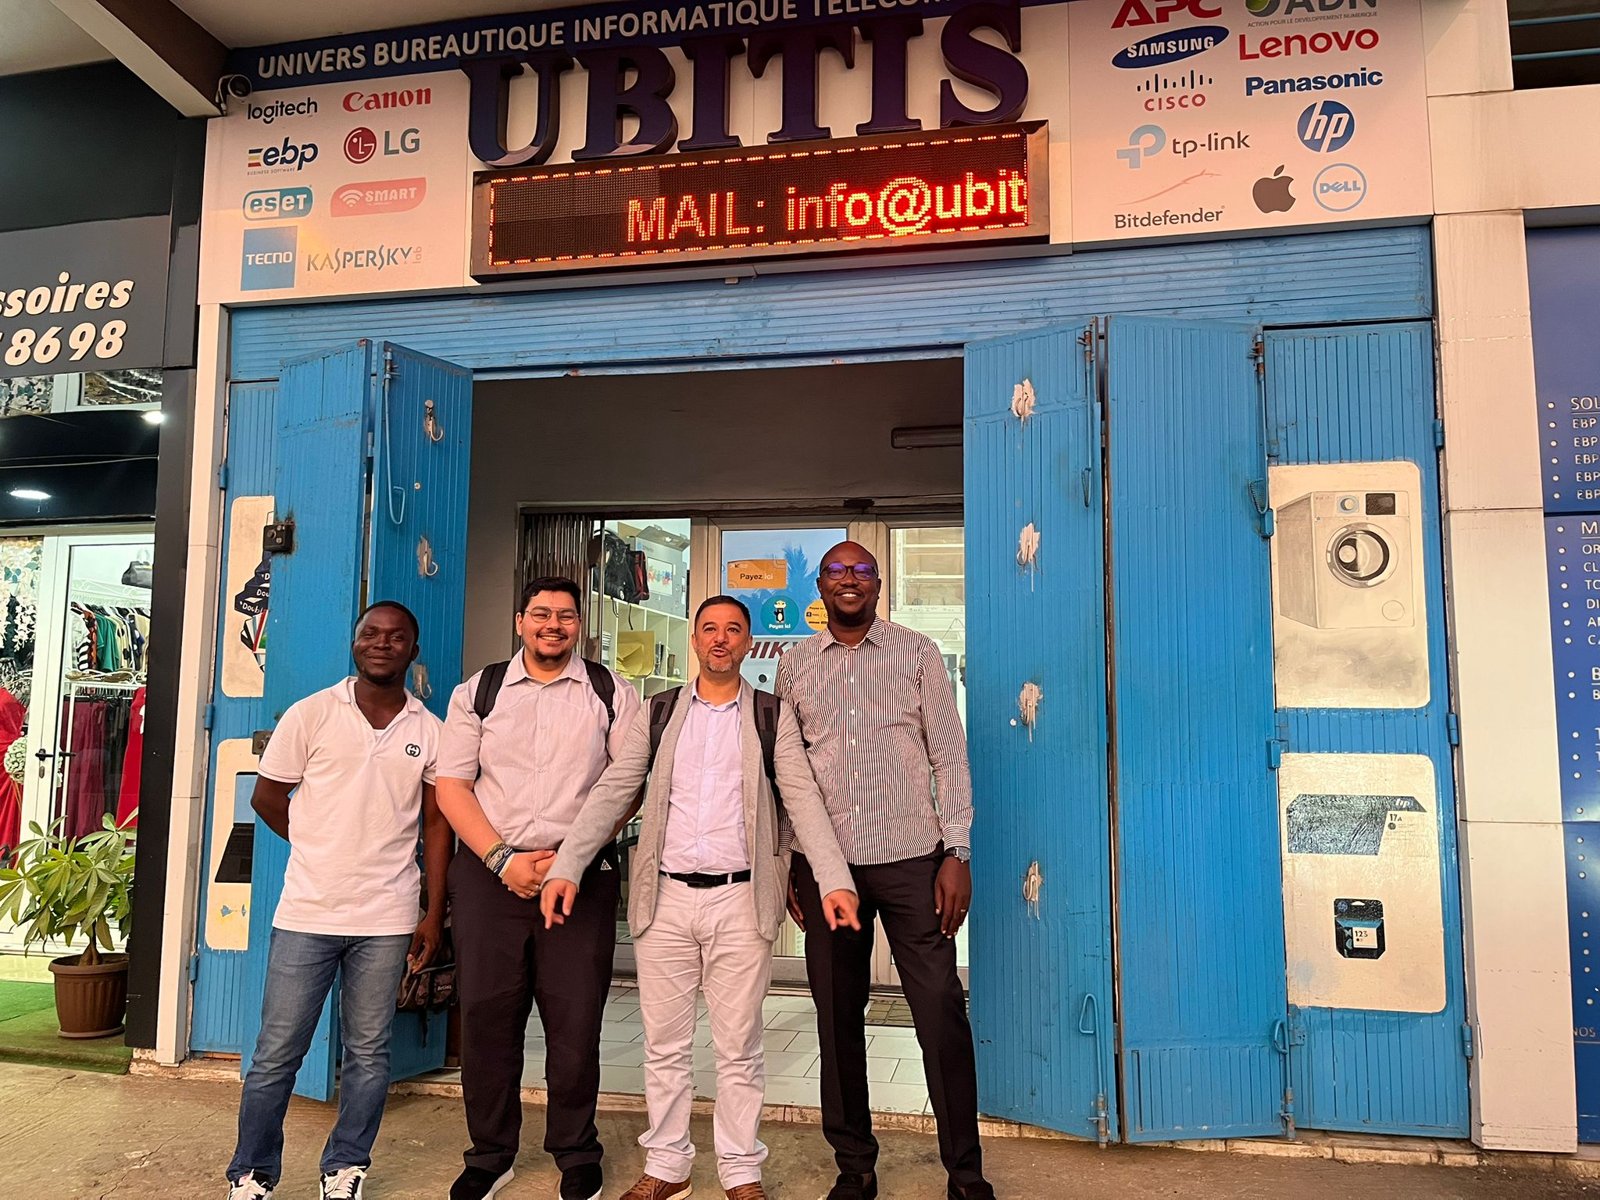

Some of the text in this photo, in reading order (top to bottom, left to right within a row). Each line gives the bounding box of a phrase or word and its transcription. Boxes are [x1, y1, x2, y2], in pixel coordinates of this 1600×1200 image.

[258, 44, 366, 79] UNIVERS
[374, 20, 565, 66] BUREAUTIQUE
[574, 0, 797, 43] INFORMATIQUE
[1127, 36, 1214, 59] SAMSUNG
[1239, 28, 1379, 61] Lenovo
[461, 0, 1029, 168] UBITIS
[1245, 67, 1383, 97] Panasonic
[247, 97, 318, 125] logitech
[342, 87, 432, 112] Canon
[1144, 93, 1206, 112] CISCO
[1303, 100, 1350, 152] hp
[262, 137, 319, 171] ebp
[383, 127, 420, 156] LG
[1172, 130, 1251, 158] tp-link
[365, 187, 417, 203] SMART
[1320, 180, 1361, 194] DELL
[627, 169, 1026, 242] MAIL: info@ubit
[1114, 206, 1223, 229] Bitdefender
[245, 251, 293, 266] TECNO
[307, 244, 414, 274] KASPERSKY
[0, 271, 135, 318] soires
[1572, 418, 1597, 429] EBP
[1573, 436, 1599, 447] EBP
[1575, 454, 1600, 465] EBP
[1576, 472, 1600, 482] EBP
[740, 573, 763, 581] Payez
[748, 641, 798, 658] HIK
